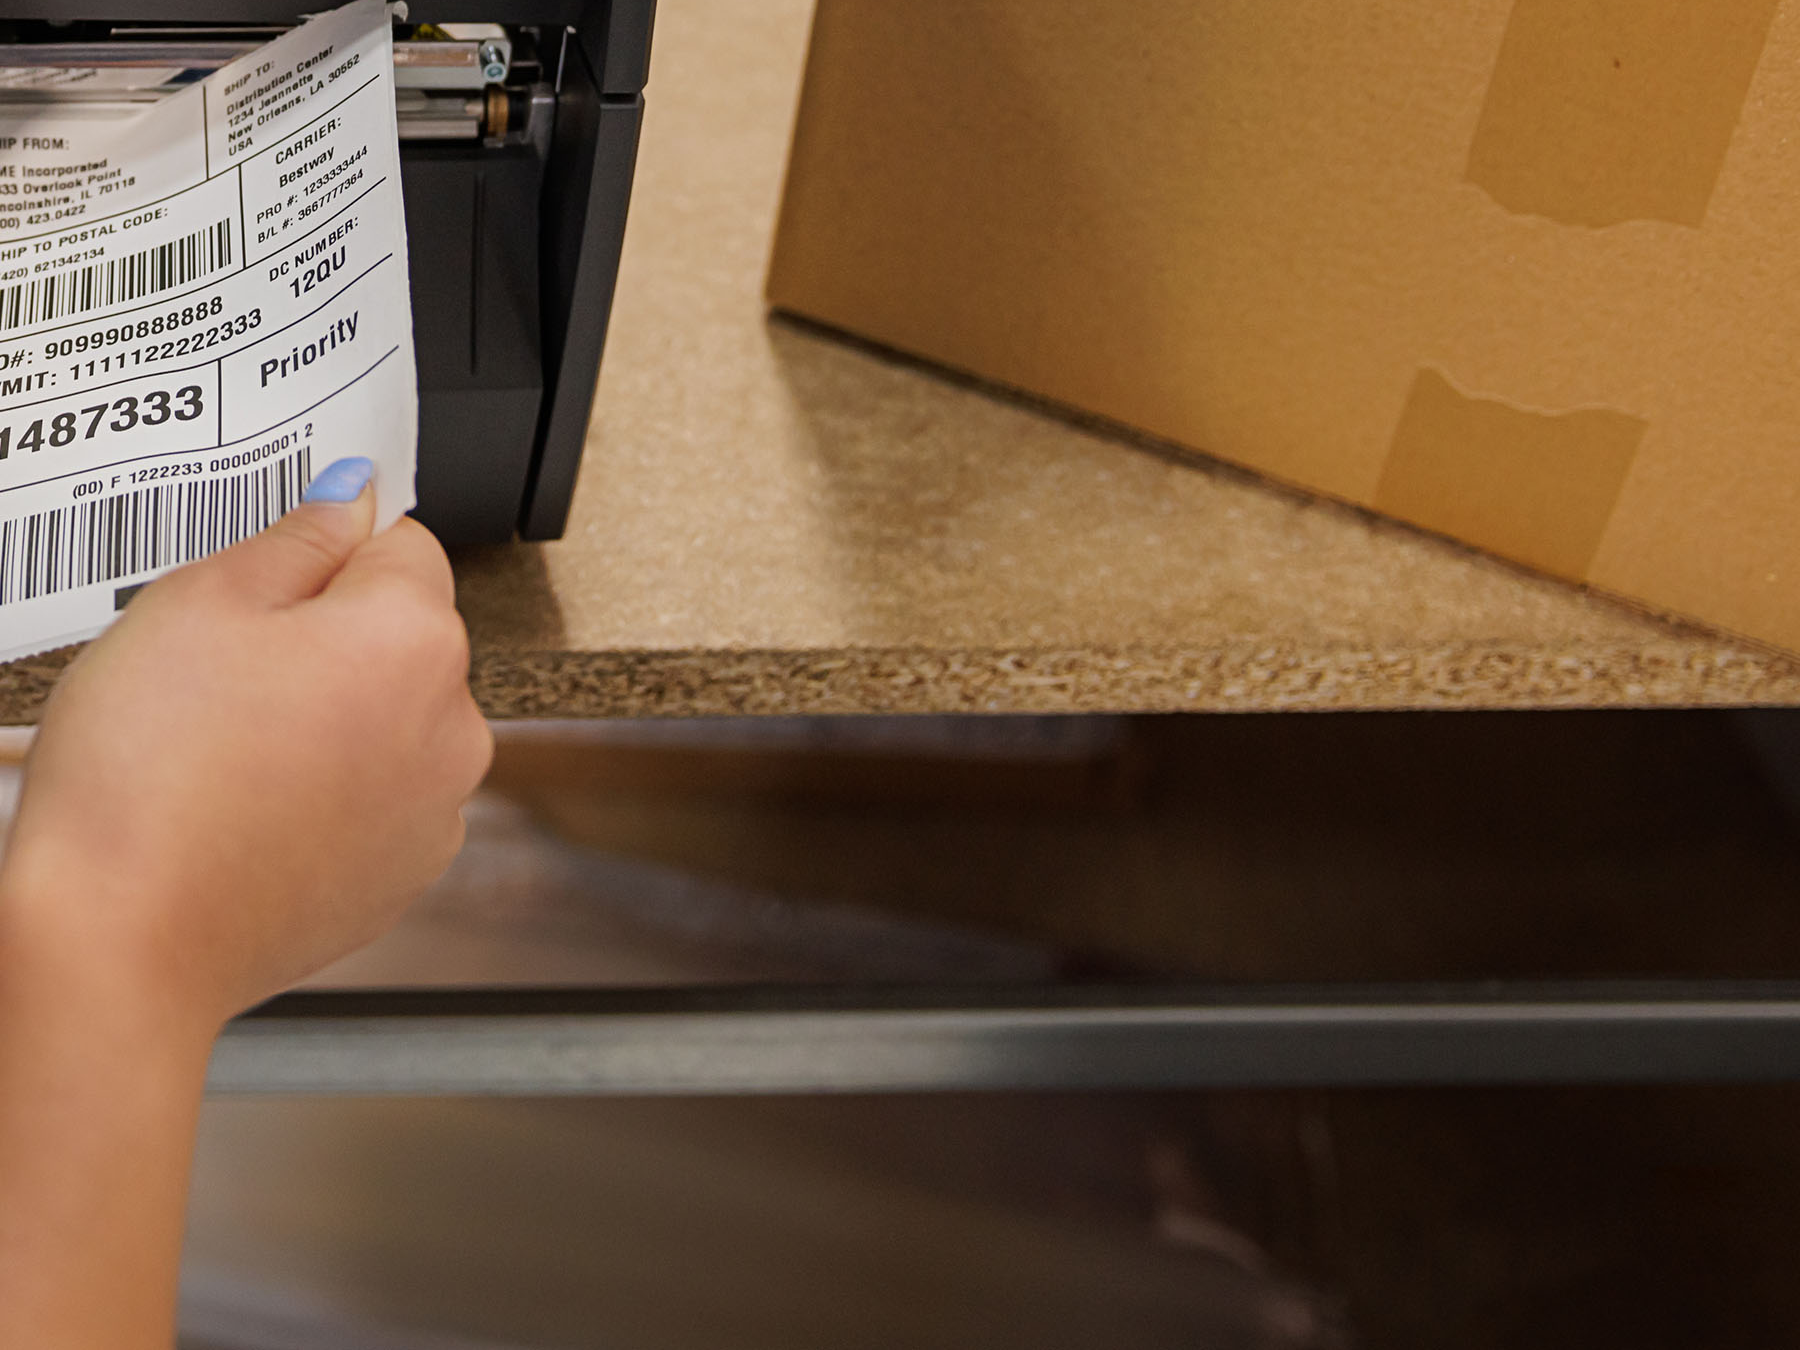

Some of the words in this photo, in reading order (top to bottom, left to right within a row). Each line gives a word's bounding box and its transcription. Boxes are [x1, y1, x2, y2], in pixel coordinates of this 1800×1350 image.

[224, 74, 250, 95] SHIP
[256, 60, 275, 76] TO:
[227, 71, 292, 115] Distribution
[297, 45, 334, 73] Center
[228, 125, 252, 142] New
[257, 96, 305, 126] Orleans,
[310, 81, 324, 95] LA
[329, 54, 360, 83] 30552
[228, 107, 254, 128] 1234
[258, 74, 313, 111] Jeannette
[23, 138, 69, 150] FROM:
[229, 137, 253, 156] USA
[276, 117, 342, 164] CARRIER:
[23, 159, 107, 177] Incorporated
[24, 178, 82, 194] Overlook
[88, 168, 121, 184] Point
[256, 202, 282, 223] PRO
[287, 194, 298, 208] #:
[304, 146, 367, 196] 1233333444
[279, 147, 335, 188] Bestway
[27, 204, 86, 225] 423.0422
[81, 191, 92, 200] IL
[258, 226, 278, 243] B/L
[282, 218, 293, 230] #:
[298, 169, 363, 221] 3667777364
[34, 241, 51, 253] TO
[59, 224, 117, 247] POSTAL
[123, 208, 168, 229] CODE:
[269, 261, 289, 282] DC
[294, 217, 359, 267] NUMBER:
[289, 246, 346, 298] 12QU
[44, 296, 223, 360] 909990888888
[68, 308, 262, 381] 1111122222333
[259, 311, 360, 387] Priority
[73, 480, 103, 499] (00)
[111, 476, 120, 488] F
[129, 463, 203, 484] 1222233
[210, 431, 298, 472] 000000001
[304, 423, 313, 437] 2
